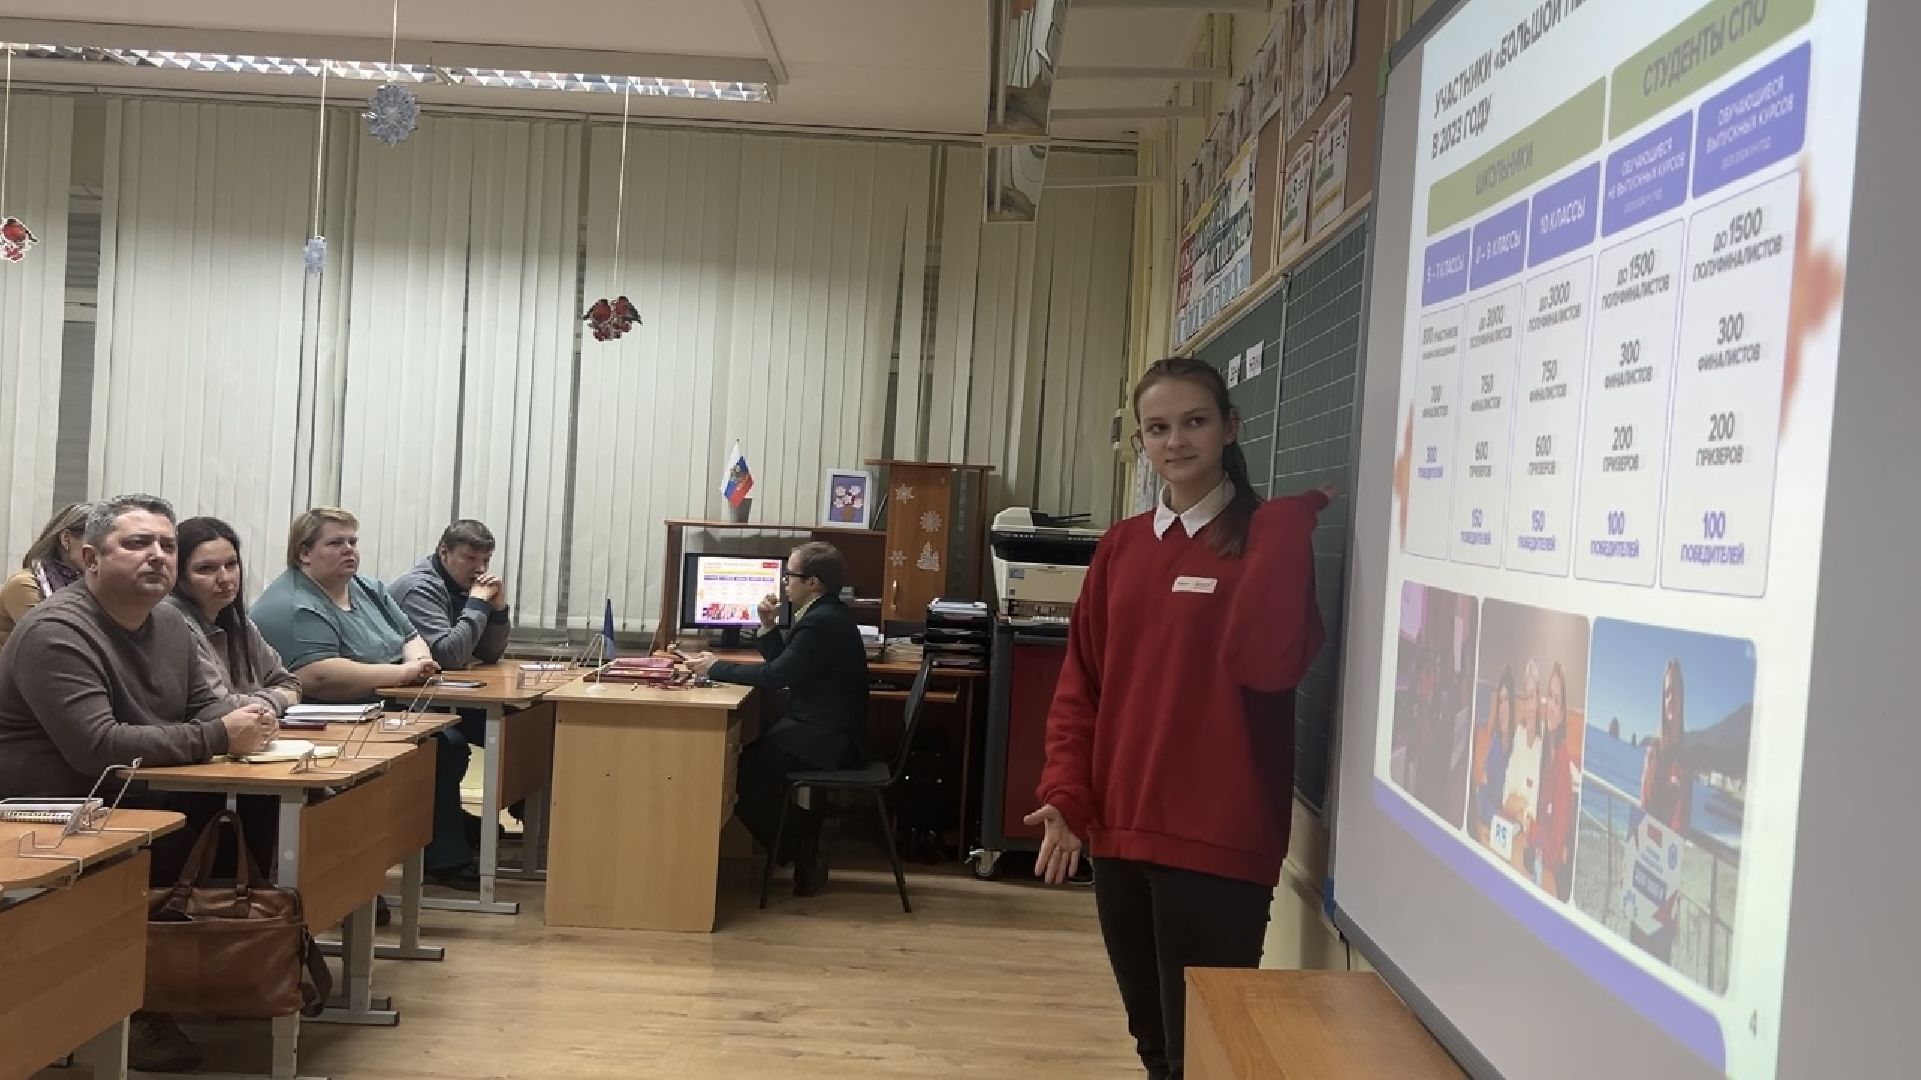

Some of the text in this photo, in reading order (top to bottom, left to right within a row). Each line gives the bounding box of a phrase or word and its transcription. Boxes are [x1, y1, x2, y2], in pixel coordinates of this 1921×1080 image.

[1643, 15, 1725, 97] СТУДЕНТЫ
[1434, 48, 1493, 120] УЧАСТНИКИ
[1432, 92, 1492, 160] В 2023 ГОДУ
[1475, 142, 1534, 196] ШКОЛЬНИКИ
[1550, 197, 1586, 232] КЛАССЫ
[1728, 206, 1763, 246] 1500
[1630, 249, 1654, 281] 1500
[1692, 233, 1784, 282] ПОЛУФИНАЛИСТОВ
[1549, 280, 1570, 307] 3000
[1717, 312, 1743, 344] 300
[1620, 339, 1639, 366] 300
[1698, 343, 1760, 372] ФИНАЛИСТОВ
[1542, 359, 1557, 383] 750
[1612, 425, 1632, 451] 200
[1708, 412, 1735, 441] 200
[1536, 435, 1551, 456] 600
[1532, 510, 1545, 531] 150
[1608, 511, 1625, 535] 100
[1703, 510, 1725, 540] 100
[1591, 540, 1639, 557] ПОБЕДИТЕЛЕЙ
[1681, 544, 1744, 565] ПОБЕДИТЕЛЕЙ
[1747, 1008, 1758, 1040] 4
